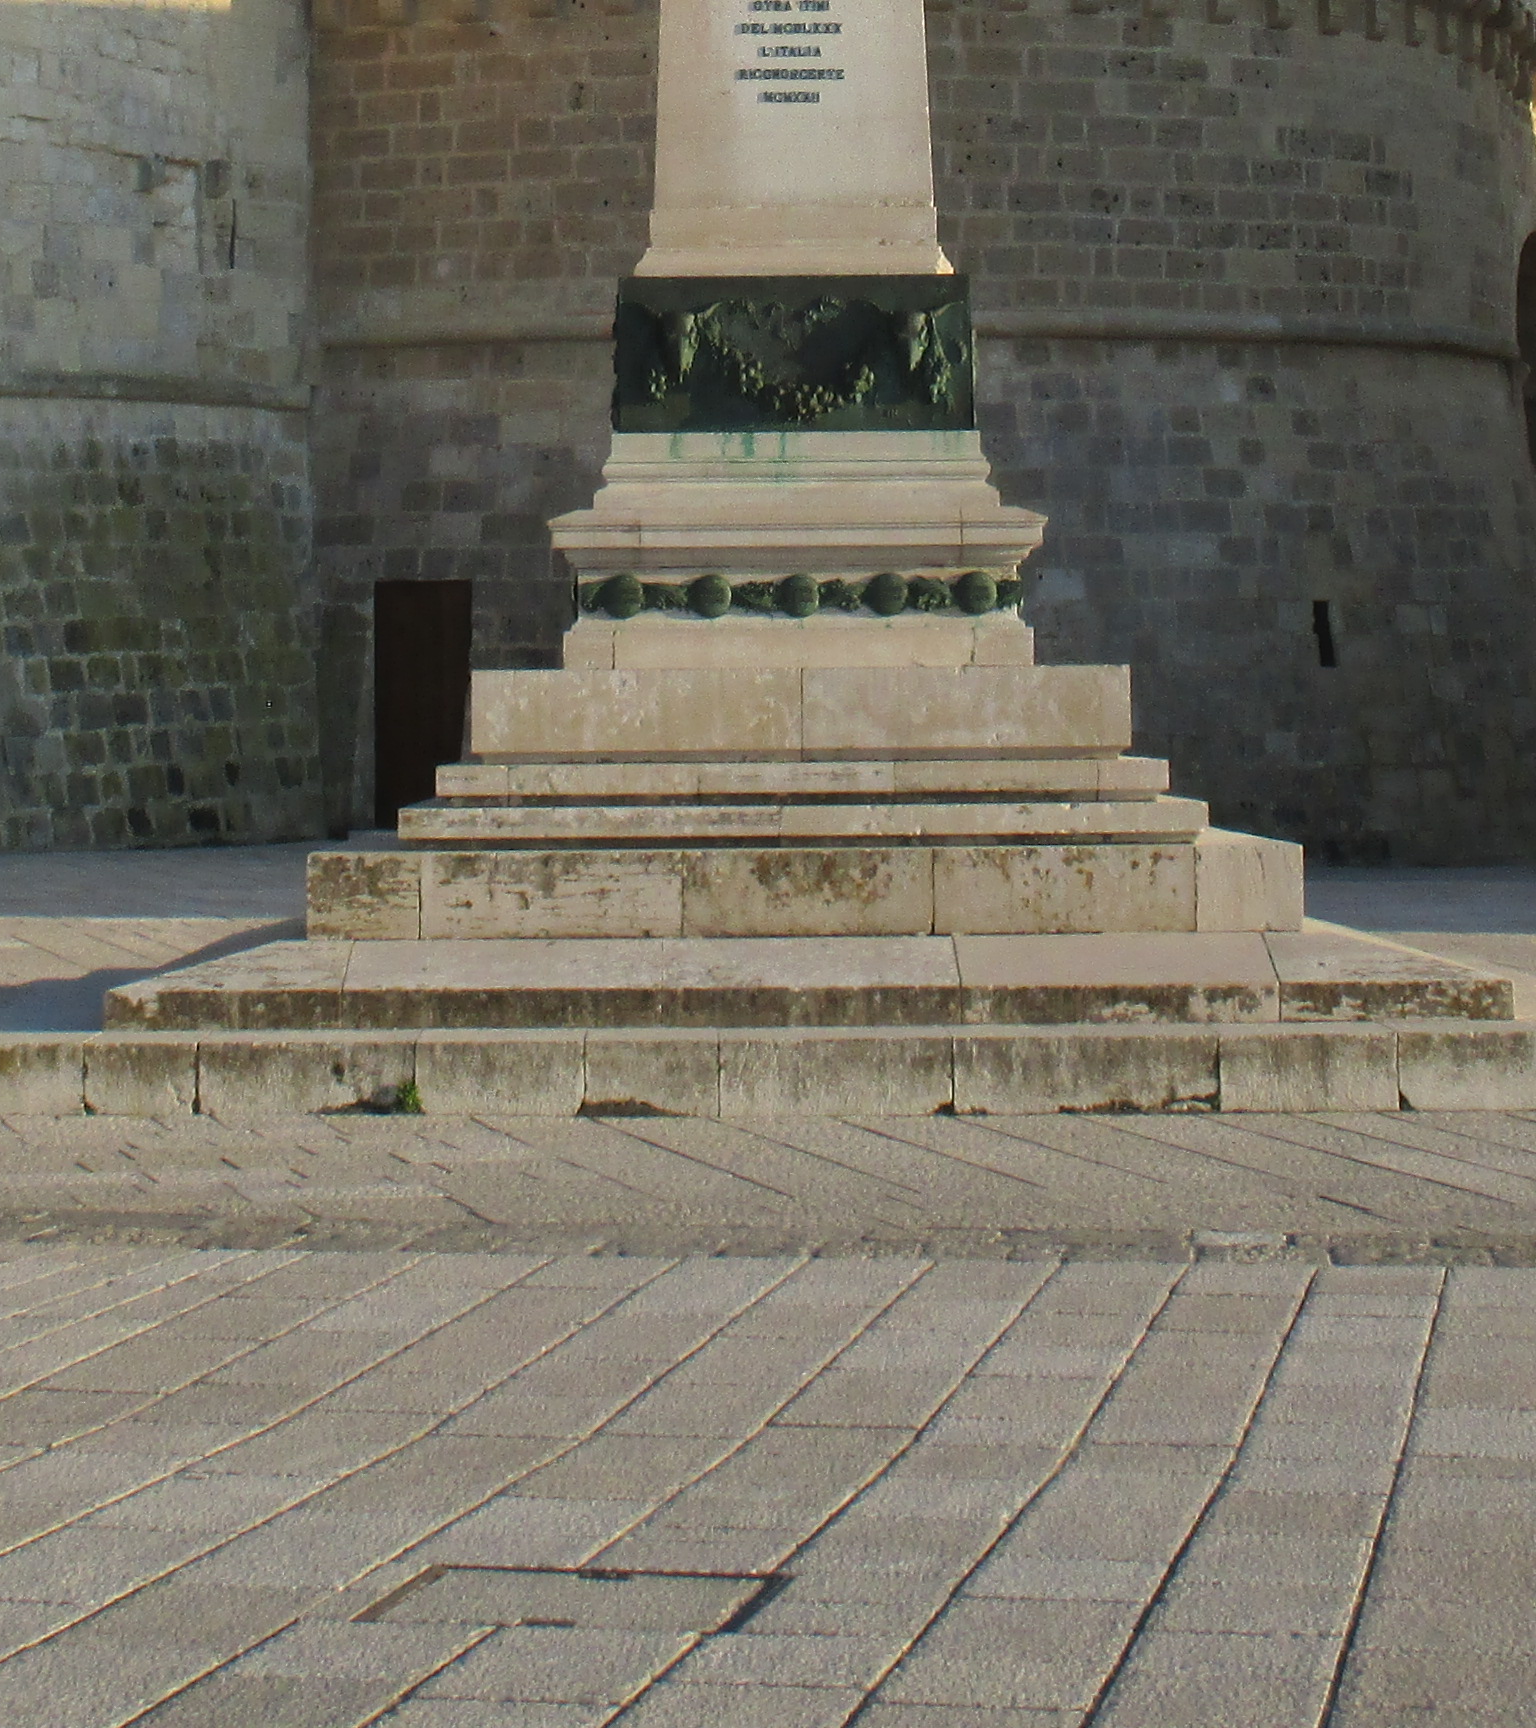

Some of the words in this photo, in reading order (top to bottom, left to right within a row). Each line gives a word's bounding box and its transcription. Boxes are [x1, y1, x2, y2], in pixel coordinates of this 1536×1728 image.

[752, 0, 830, 12] OTRATINI
[740, 22, 769, 34] DEL
[761, 46, 822, 57] L'ITALIA
